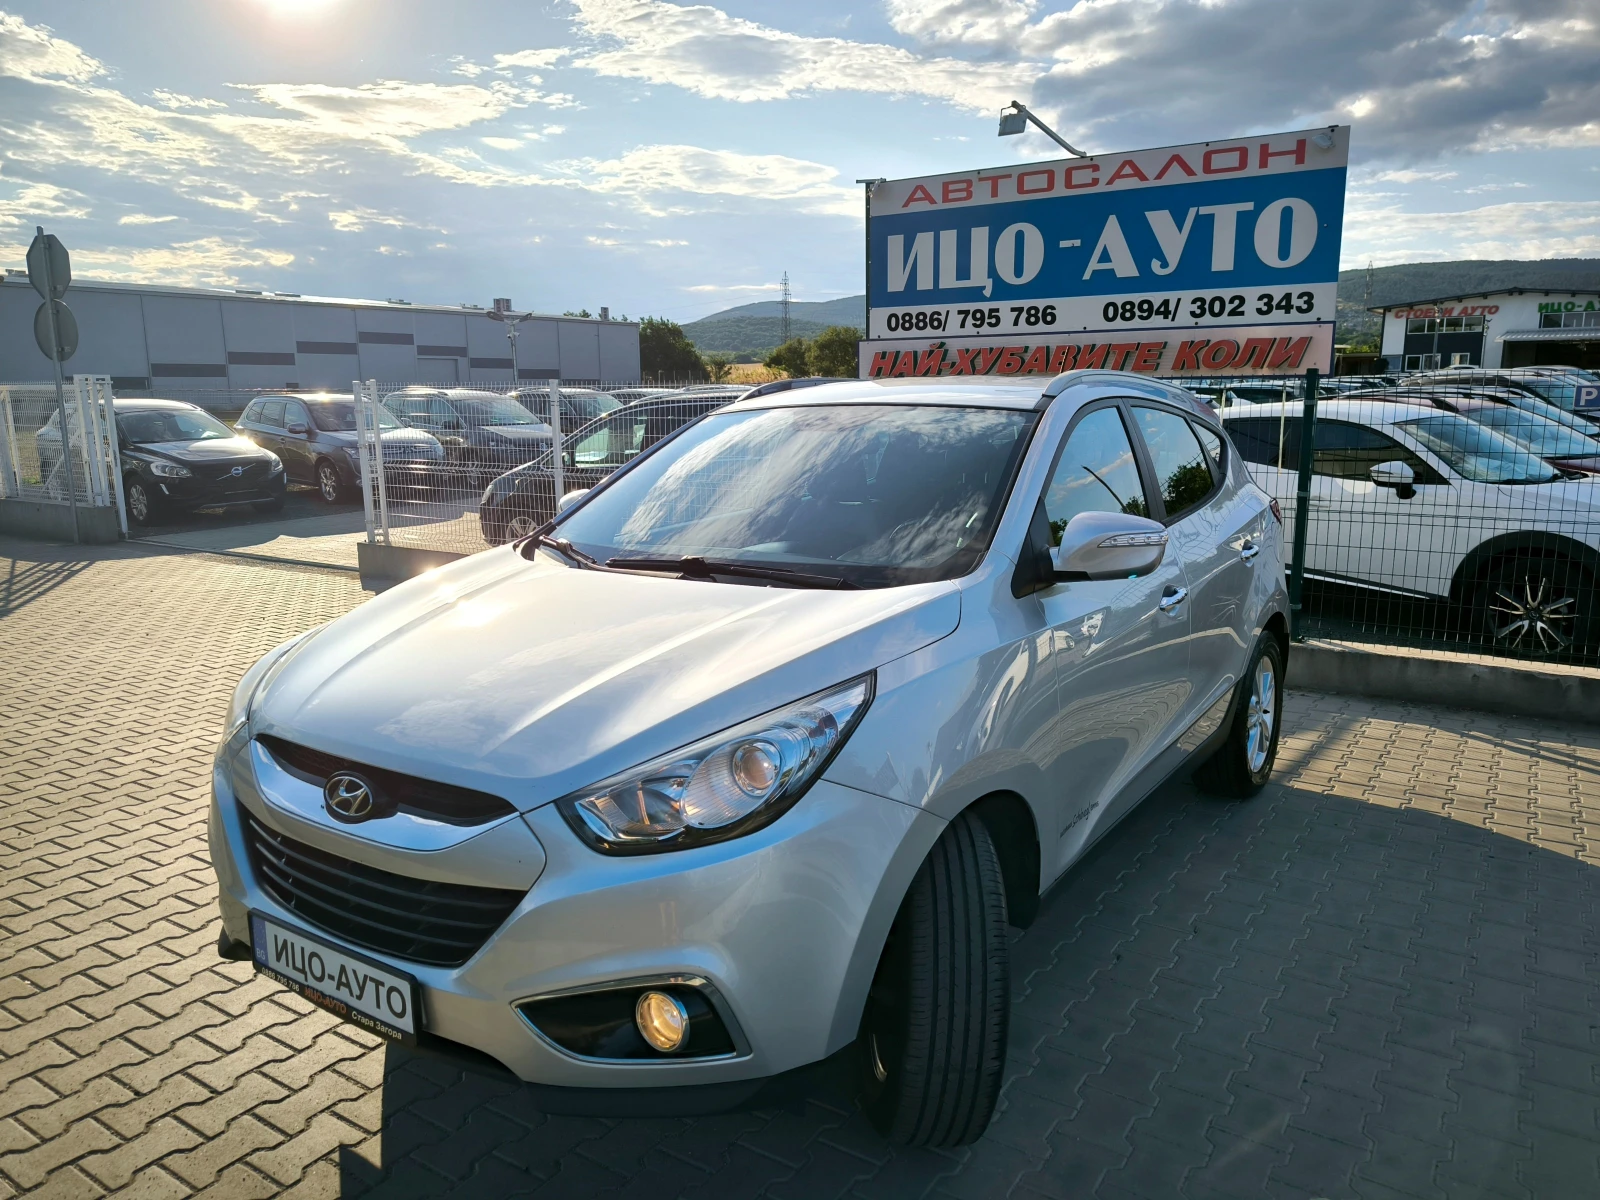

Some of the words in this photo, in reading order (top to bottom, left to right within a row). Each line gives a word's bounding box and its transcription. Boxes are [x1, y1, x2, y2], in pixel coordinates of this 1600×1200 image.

[902, 138, 1307, 208] АВТОСАЛОН
[886, 308, 949, 333] 0886/
[957, 307, 1001, 330] 795
[1009, 304, 1057, 327] 786
[1102, 297, 1181, 323] 0894/
[1188, 294, 1246, 319] 302
[1255, 291, 1315, 315] 343
[1394, 306, 1456, 319] СТОЕИ
[1457, 304, 1500, 317] АУТО
[1538, 300, 1600, 313] ИЦО-А
[868, 341, 1168, 379] НАЙ-ХУБАВИТЕ
[1171, 336, 1313, 372] КОЛИ
[1579, 387, 1598, 406] P
[256, 948, 266, 960] BG
[273, 934, 407, 1019] ИЦО-АУТО
[289, 981, 300, 992] 786
[305, 986, 347, 1014] ИЦО-АУТО
[351, 1010, 374, 1027] Стара
[375, 1021, 402, 1040] Загора
